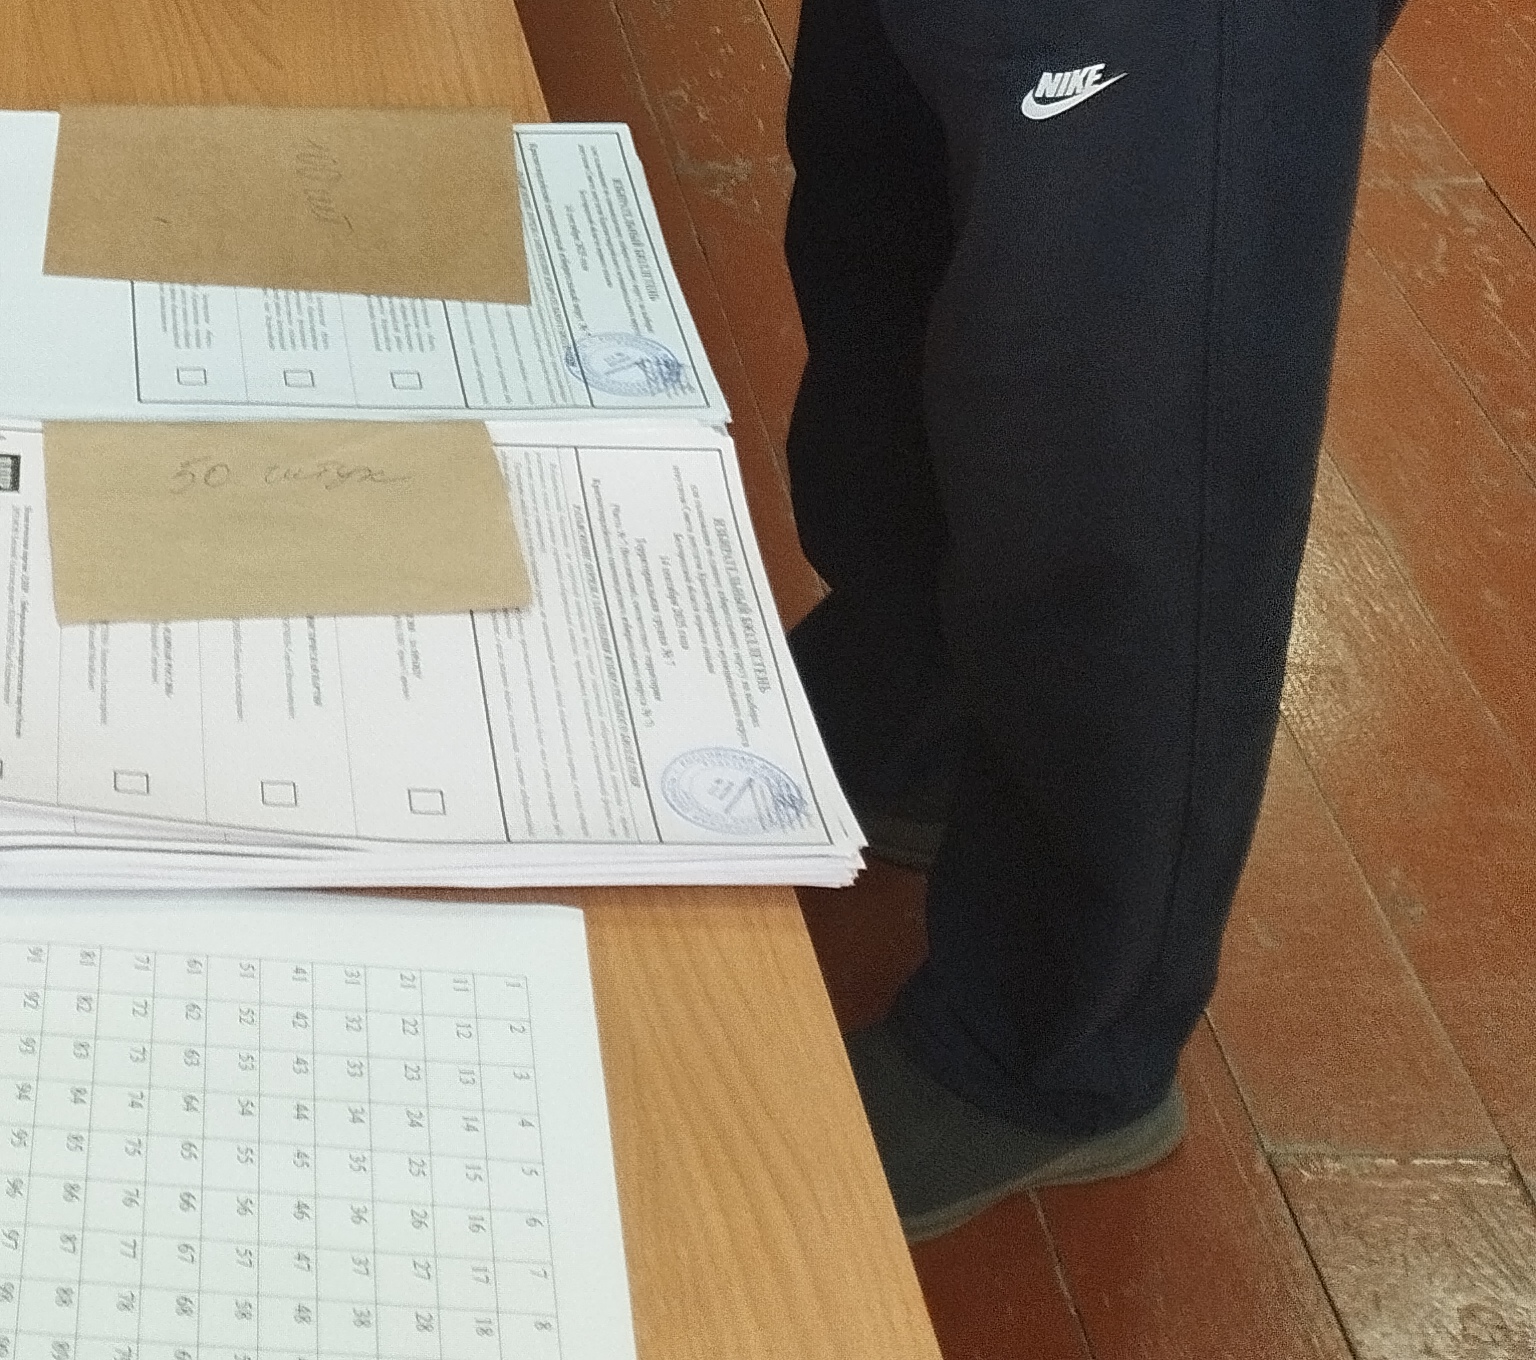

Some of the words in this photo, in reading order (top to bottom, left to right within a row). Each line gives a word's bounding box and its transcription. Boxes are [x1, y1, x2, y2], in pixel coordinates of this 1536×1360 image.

[1034, 62, 1106, 99] NIKE
[134, 955, 151, 971] 71
[186, 958, 203, 975] 61
[238, 962, 256, 979] 51
[291, 965, 308, 982] 41
[344, 969, 361, 986] 31
[399, 972, 417, 990] 21
[452, 978, 470, 993] 11
[131, 999, 149, 1018] 72
[184, 1002, 202, 1021] 62
[238, 1007, 256, 1026] 52
[291, 1011, 309, 1029] 42
[344, 1015, 363, 1033] 32
[401, 1017, 420, 1036] 22
[508, 1024, 527, 1034] 2
[455, 1022, 473, 1039] 12
[129, 1046, 147, 1063] 73
[183, 1048, 201, 1067] 63
[237, 1052, 256, 1071] 53
[292, 1055, 310, 1075] 43
[346, 1059, 364, 1078] 33
[403, 1063, 422, 1082] 23
[458, 1069, 477, 1086] 13
[512, 1071, 531, 1081] 3
[128, 1091, 145, 1109] 74
[183, 1094, 199, 1113] 64
[237, 1099, 255, 1117] 54
[294, 1102, 309, 1121] 44
[348, 1107, 365, 1125] 34
[405, 1109, 424, 1128] 24
[462, 1116, 480, 1133] 14
[518, 1118, 535, 1128] 4
[124, 1138, 143, 1157] 75
[180, 1140, 199, 1160] 65
[236, 1146, 255, 1165] 55
[292, 1149, 311, 1169] 45
[348, 1153, 368, 1173] 35
[407, 1157, 427, 1178] 25
[464, 1164, 484, 1182] 15
[521, 1166, 540, 1177] 5
[121, 1188, 140, 1208] 76
[179, 1191, 196, 1212] 66
[236, 1196, 254, 1216] 56
[293, 1200, 311, 1221] 46
[350, 1205, 369, 1226] 36
[410, 1208, 429, 1230] 26
[468, 1215, 487, 1234] 16
[525, 1216, 544, 1228] 6
[121, 1239, 138, 1260] 77
[177, 1242, 196, 1264] 67
[235, 1247, 254, 1269] 57
[295, 1251, 312, 1272] 47
[351, 1256, 371, 1277] 37
[412, 1259, 432, 1281] 27
[471, 1266, 491, 1285] 17
[530, 1268, 549, 1280] 7
[116, 1291, 136, 1312] 78
[175, 1295, 194, 1317] 68
[234, 1300, 253, 1320] 58
[293, 1303, 312, 1324] 48
[352, 1308, 372, 1328] 38
[414, 1311, 434, 1333] 28
[475, 1319, 494, 1337] 18
[534, 1321, 553, 1331] 8
